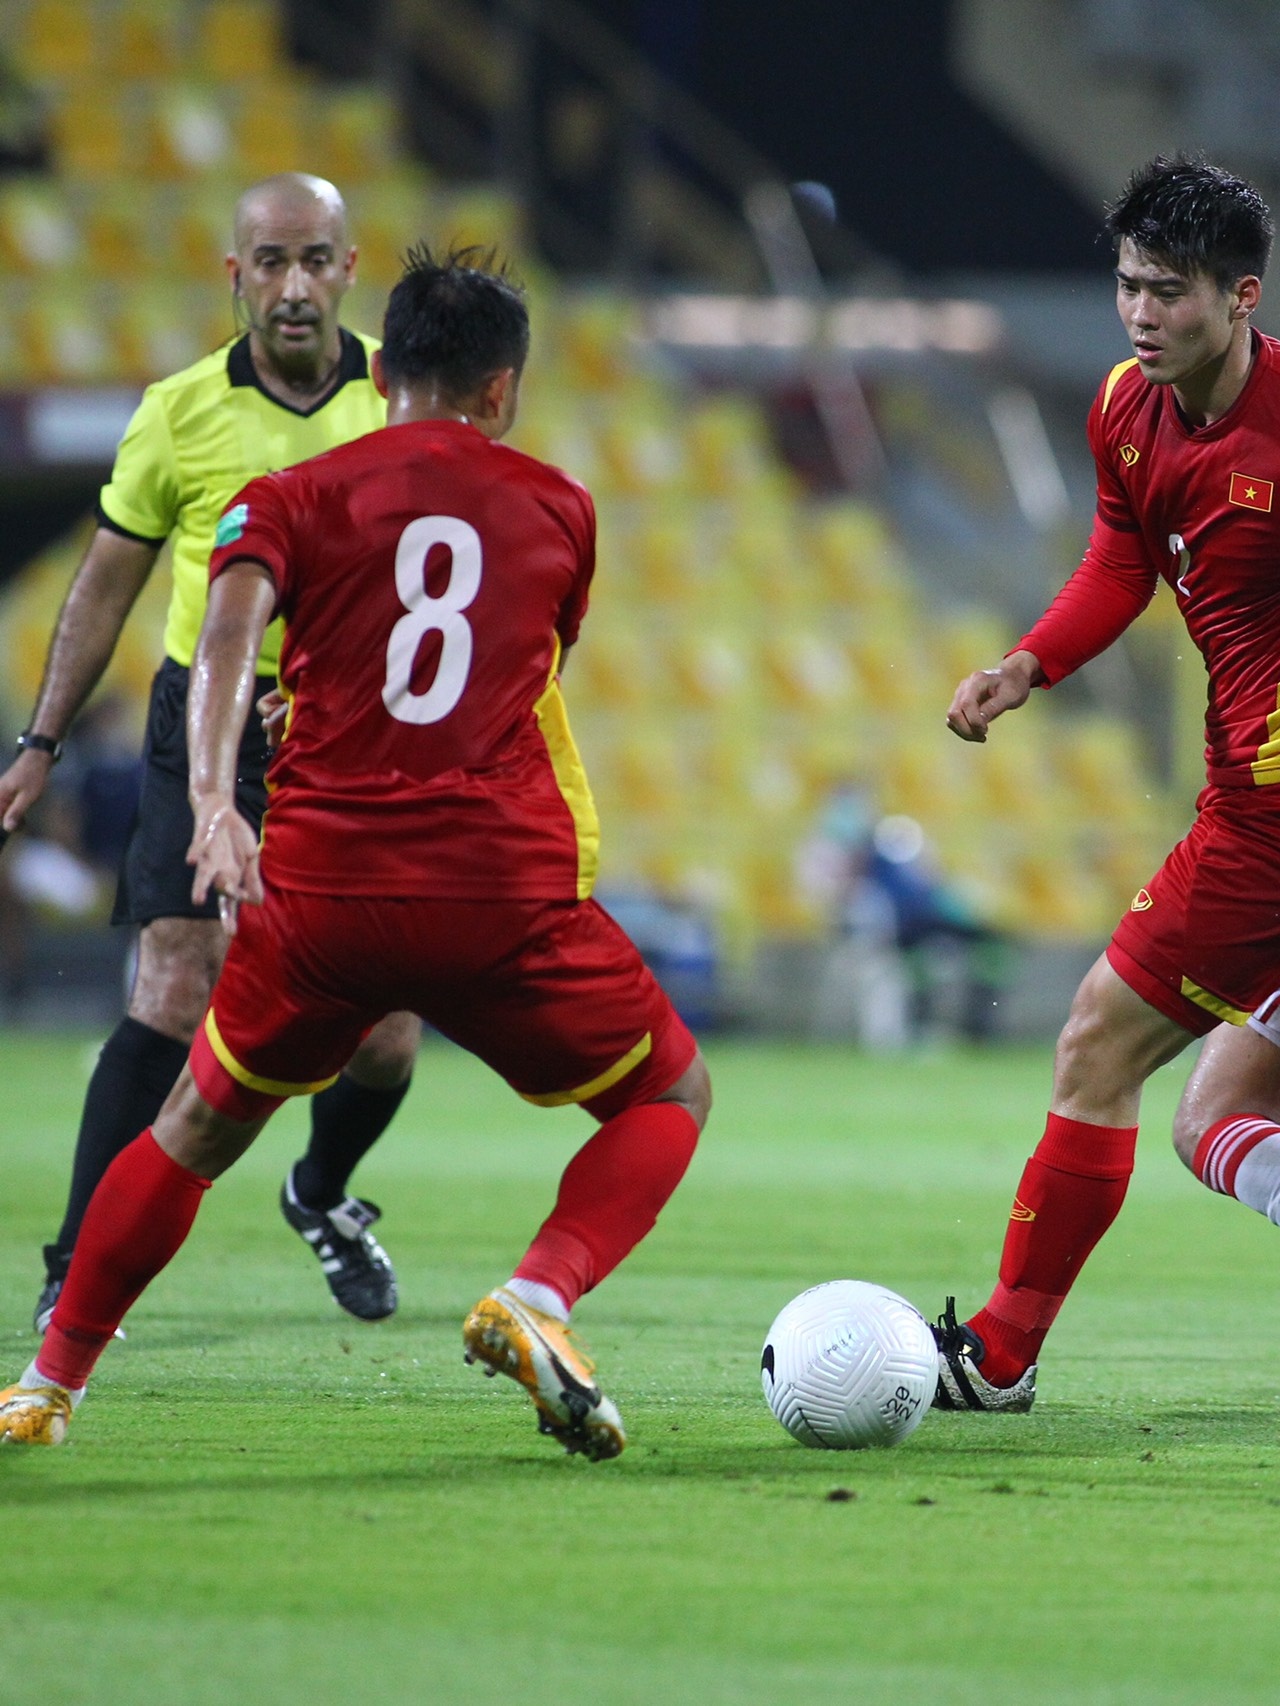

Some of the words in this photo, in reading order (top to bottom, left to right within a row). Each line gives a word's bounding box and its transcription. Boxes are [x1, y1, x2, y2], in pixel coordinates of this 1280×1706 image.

[381, 514, 483, 725] 8
[886, 1386, 910, 1414] 20
[899, 1397, 921, 1421] 21
